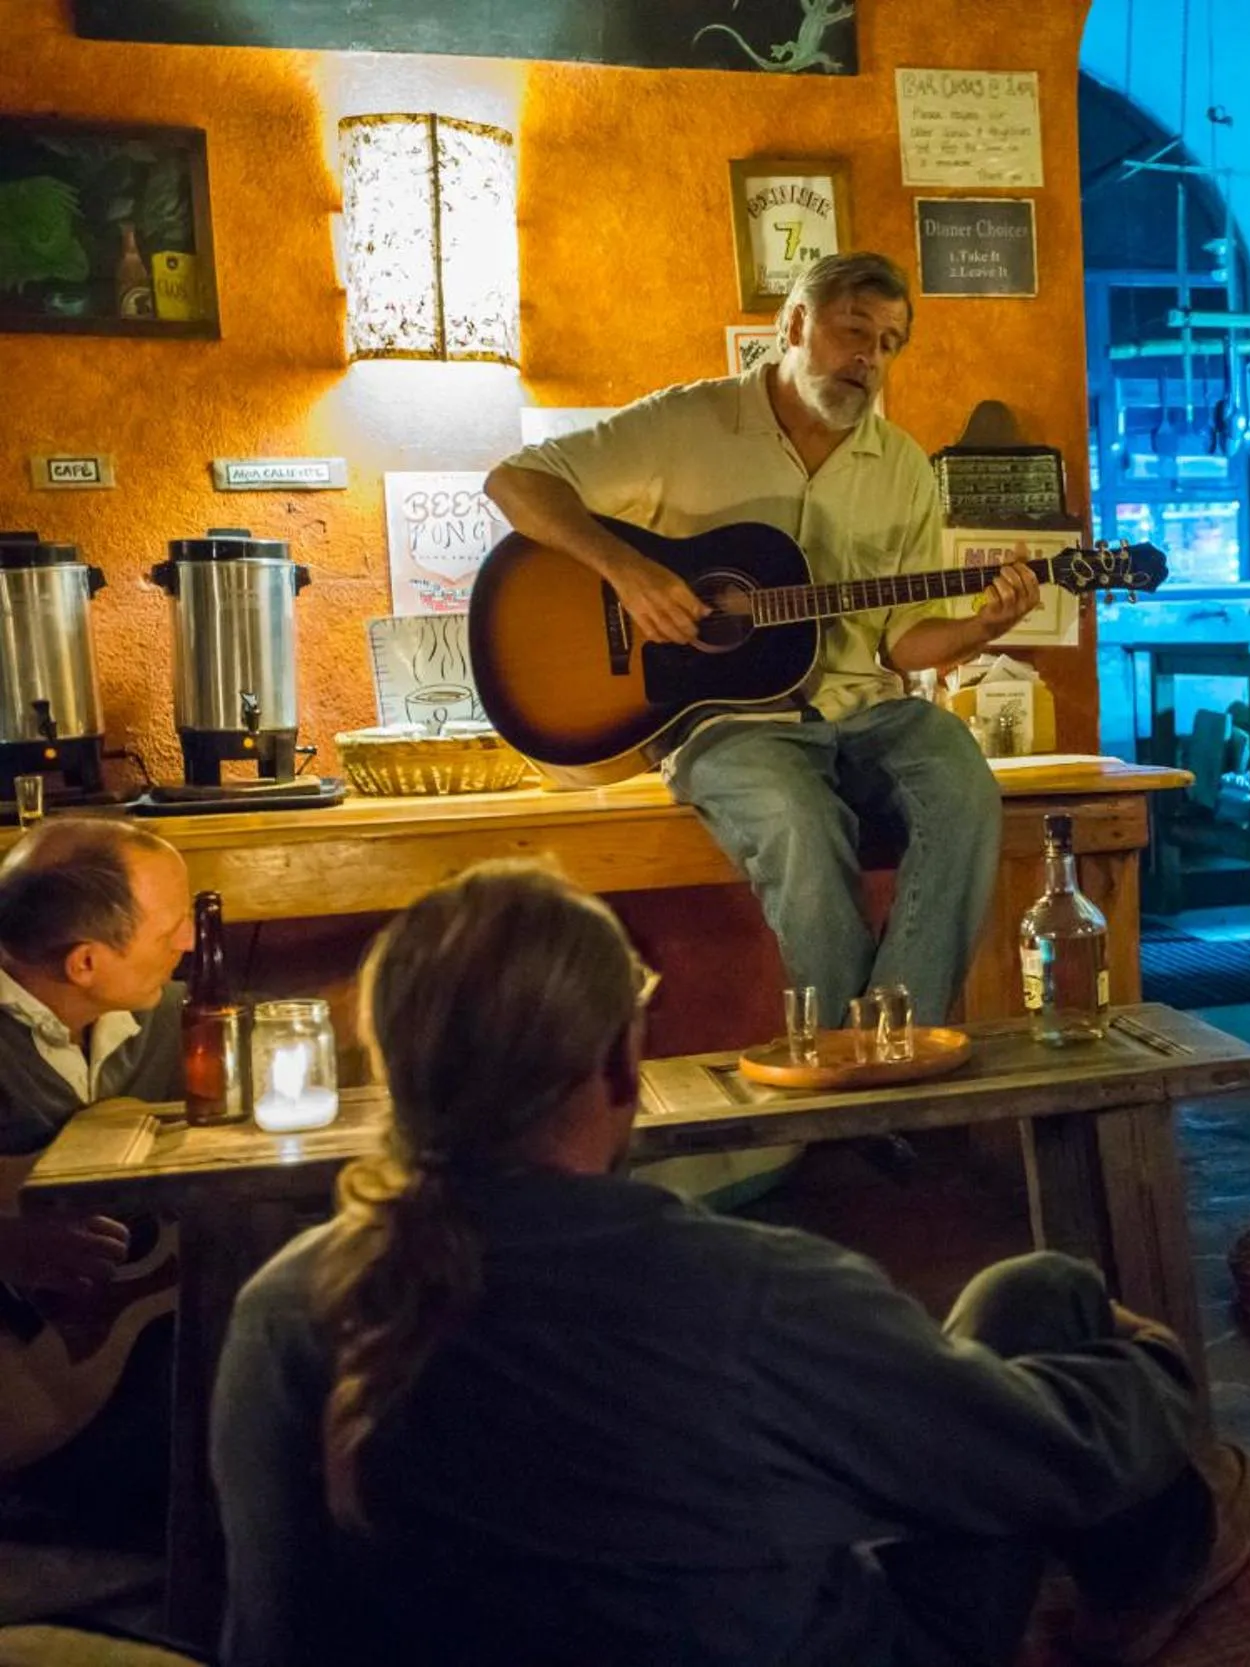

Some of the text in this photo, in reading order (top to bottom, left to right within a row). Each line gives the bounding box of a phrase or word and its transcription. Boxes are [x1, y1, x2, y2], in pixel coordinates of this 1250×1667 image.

[773, 221, 804, 261] 7
[924, 218, 972, 238] Dinner
[800, 246, 822, 263] PM
[403, 490, 501, 524] BEER
[410, 520, 487, 554] PONG
